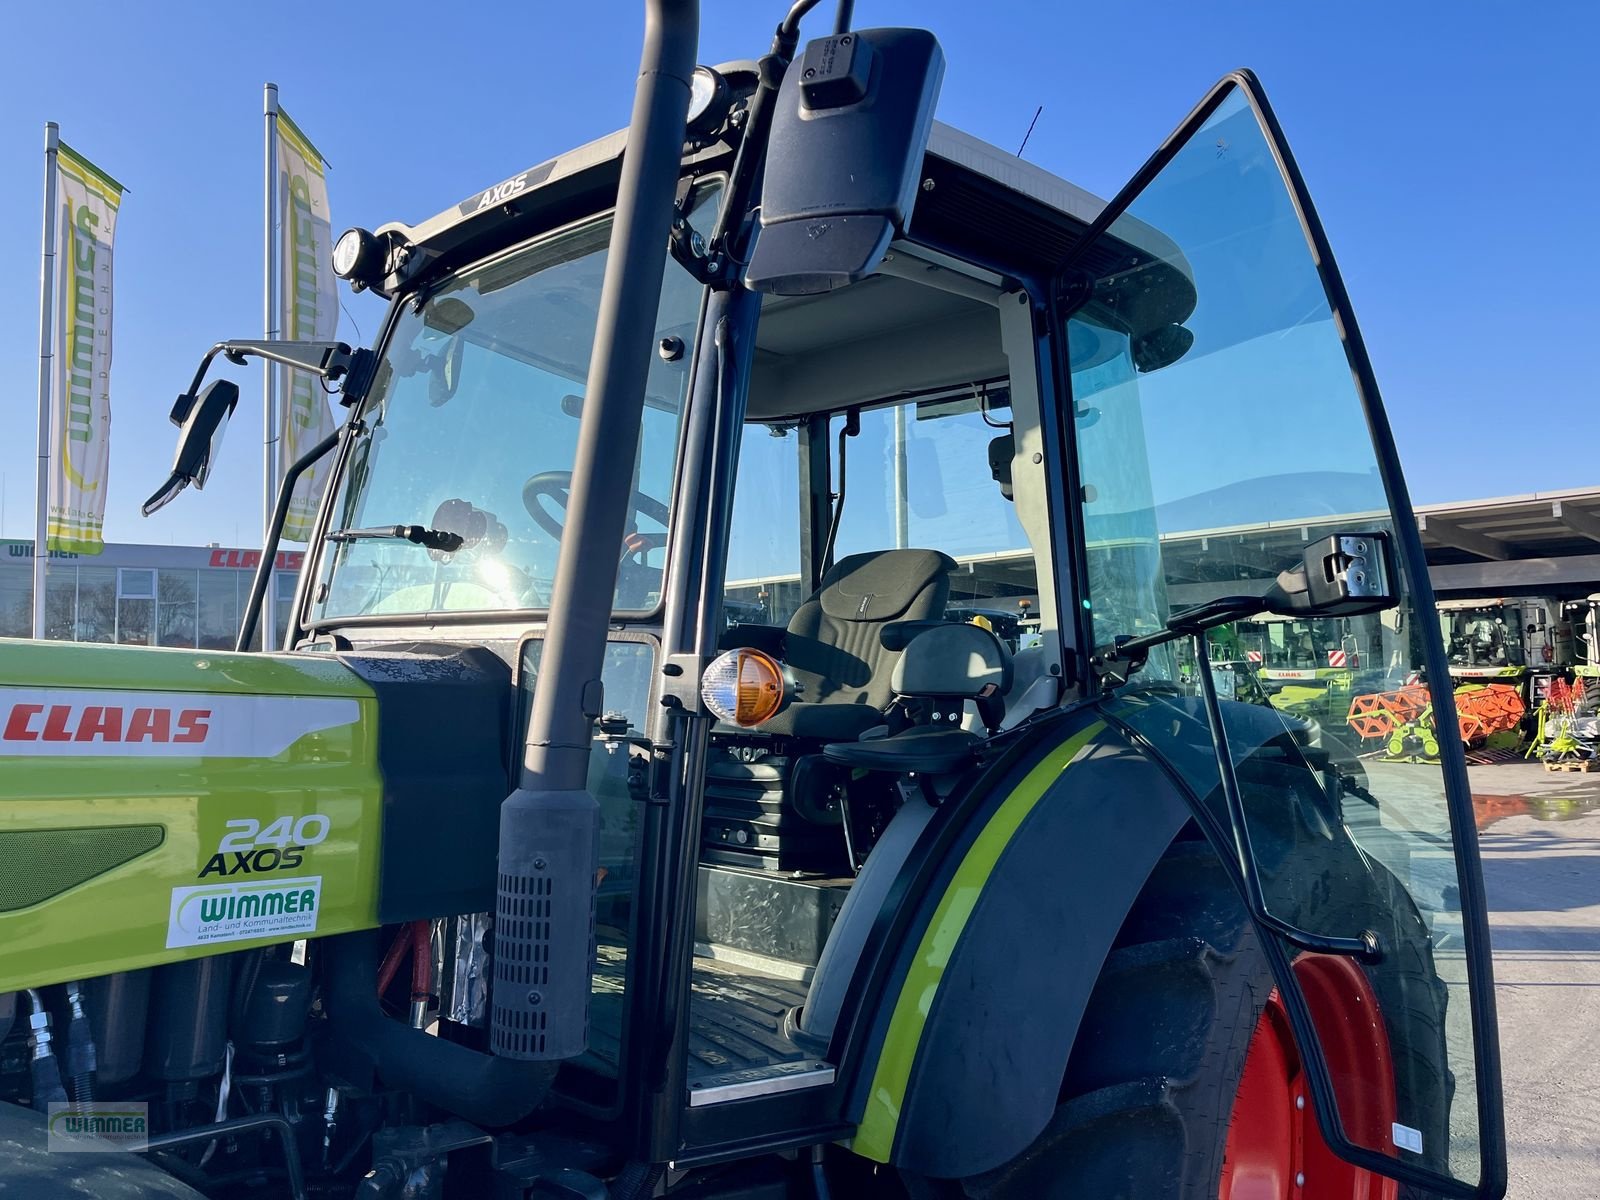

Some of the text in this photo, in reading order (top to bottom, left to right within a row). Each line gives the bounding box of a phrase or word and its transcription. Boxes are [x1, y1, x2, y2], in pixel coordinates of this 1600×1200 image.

[477, 173, 528, 210] AXOS
[2, 703, 212, 743] CLAAS
[217, 813, 331, 854] 240
[197, 845, 306, 879] AXOS
[197, 913, 313, 933] Land- und Kommunaltechnik
[200, 889, 316, 923] WIMMER
